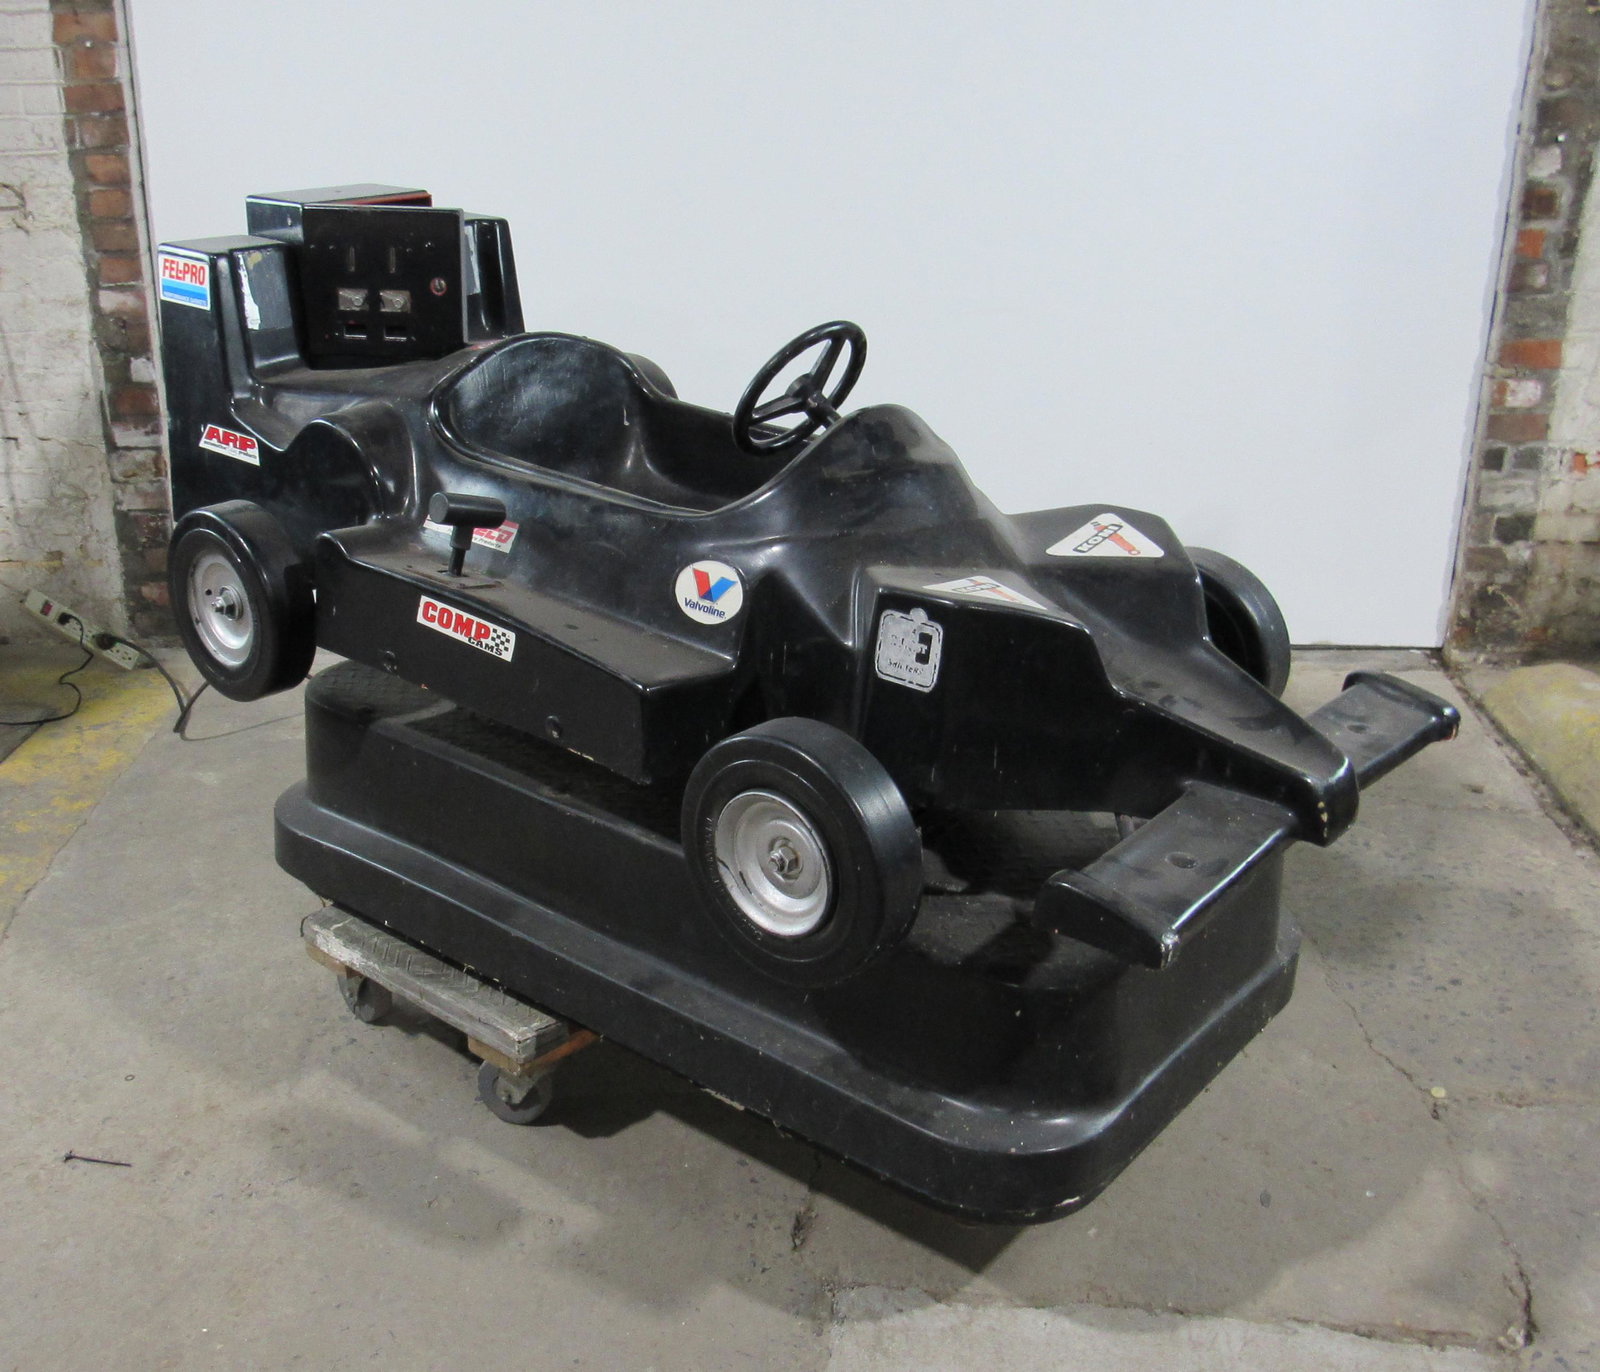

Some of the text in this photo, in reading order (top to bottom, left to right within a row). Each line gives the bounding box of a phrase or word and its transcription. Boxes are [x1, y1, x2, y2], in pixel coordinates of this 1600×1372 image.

[162, 258, 206, 286] FEL-PRO
[204, 427, 257, 452] ARP
[1074, 523, 1123, 553] KONI
[684, 597, 726, 618] Valvoline
[422, 601, 491, 641] COMP
[467, 636, 503, 656] CAMS
